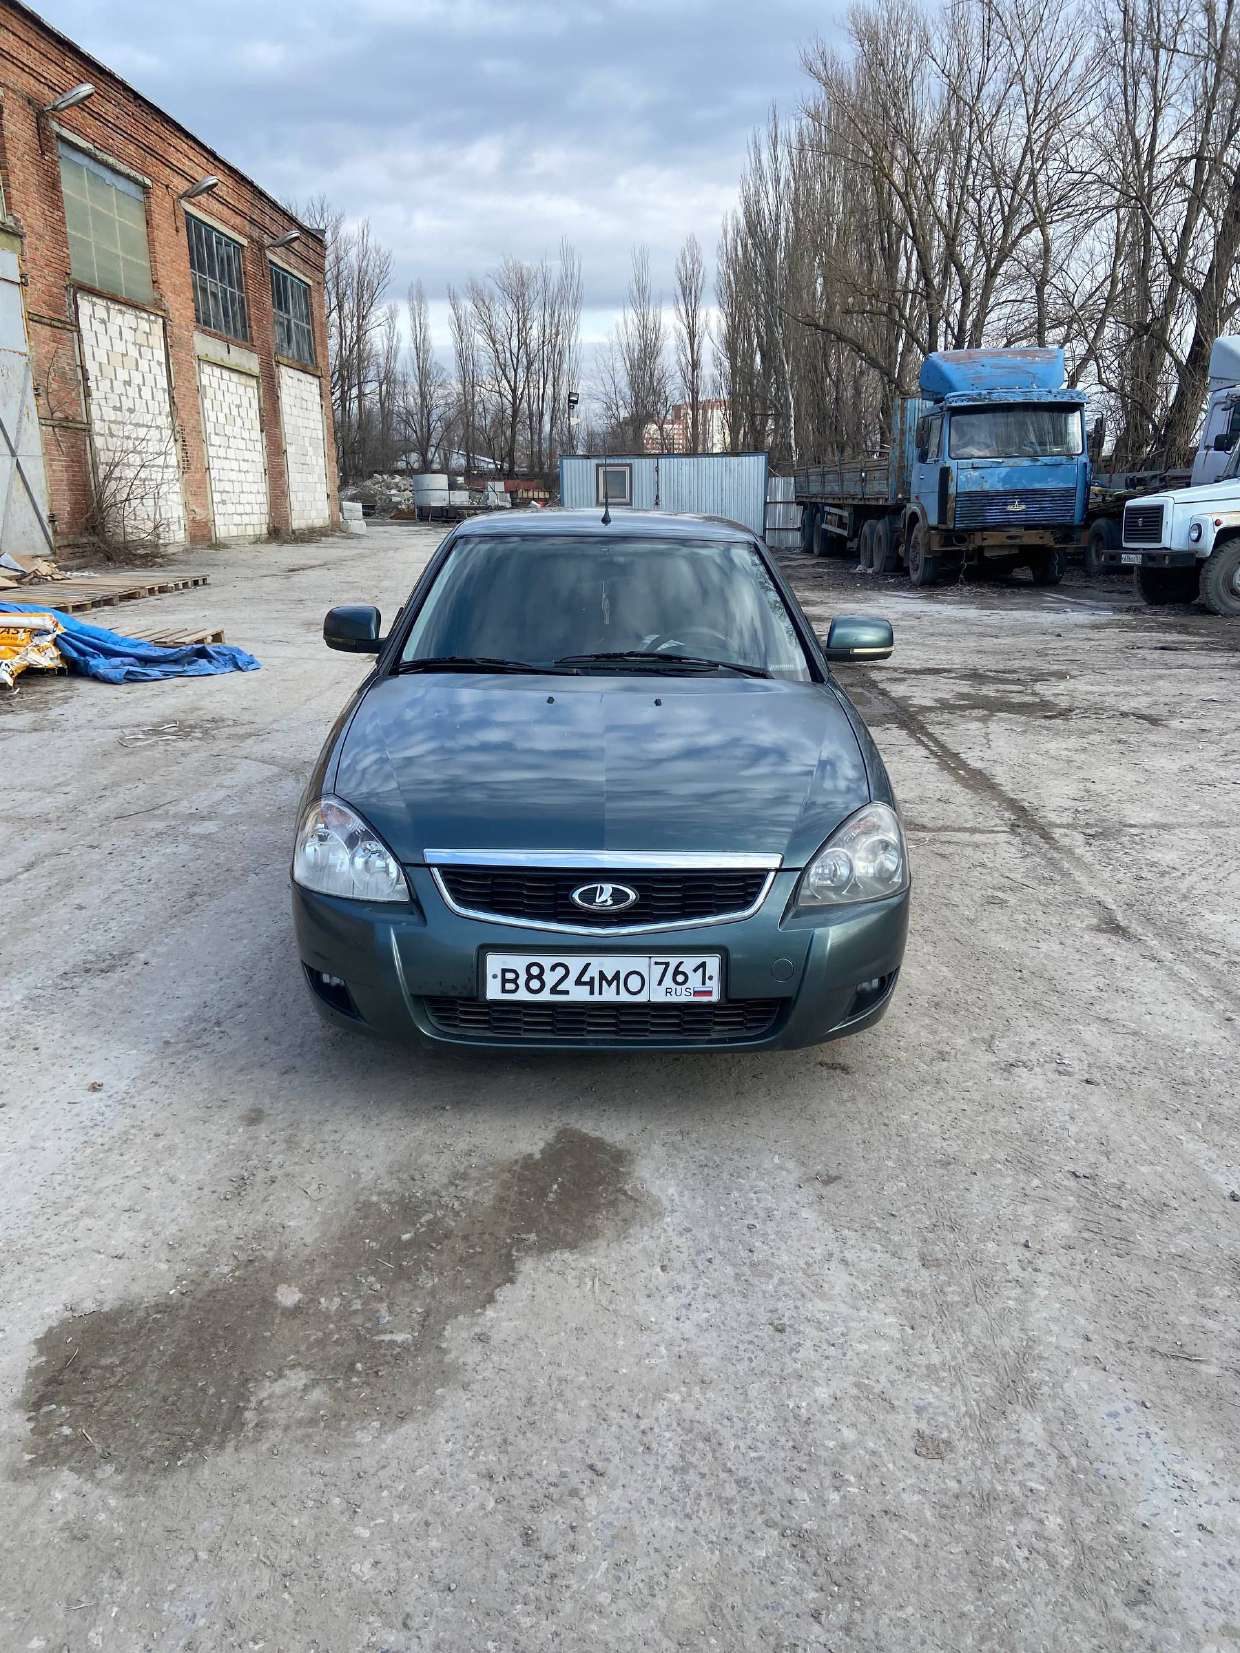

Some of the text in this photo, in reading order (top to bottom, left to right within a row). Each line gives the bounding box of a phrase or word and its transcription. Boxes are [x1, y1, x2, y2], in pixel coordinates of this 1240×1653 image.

[500, 961, 707, 996] В824МО 761
[665, 987, 692, 997] RUS
